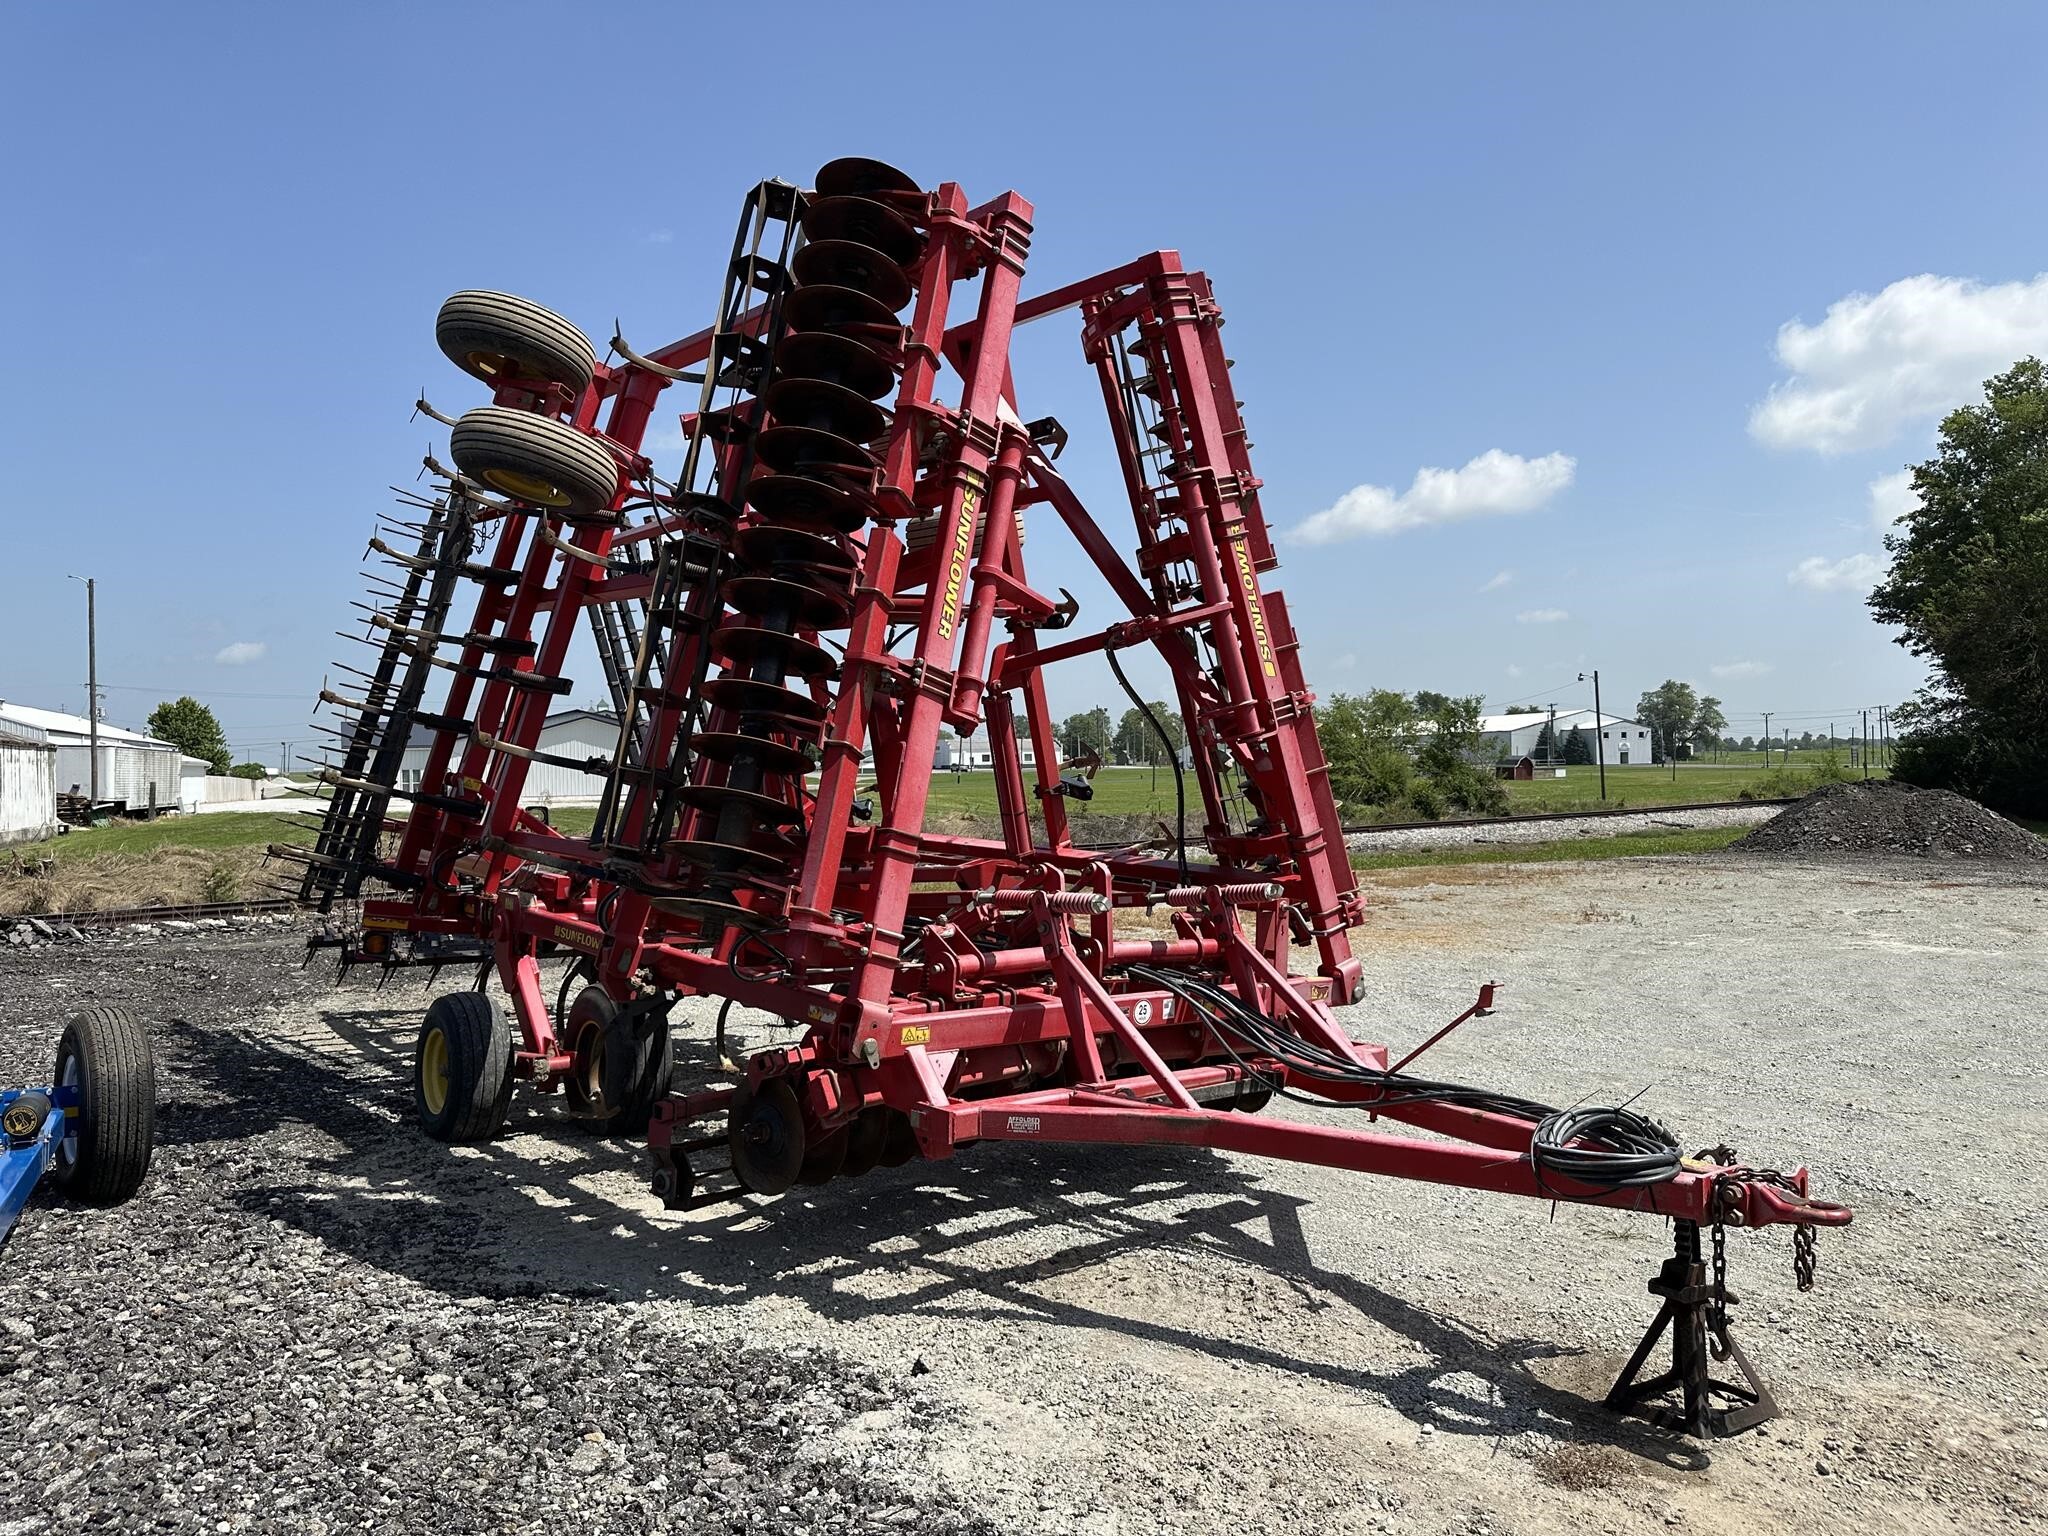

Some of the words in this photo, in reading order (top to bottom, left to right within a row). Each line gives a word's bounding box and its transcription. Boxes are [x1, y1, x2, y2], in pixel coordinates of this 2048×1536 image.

[938, 485, 976, 641] SUNFLOWER
[1230, 525, 1272, 662] SUNFLOWER
[1138, 1004, 1148, 1015] 25
